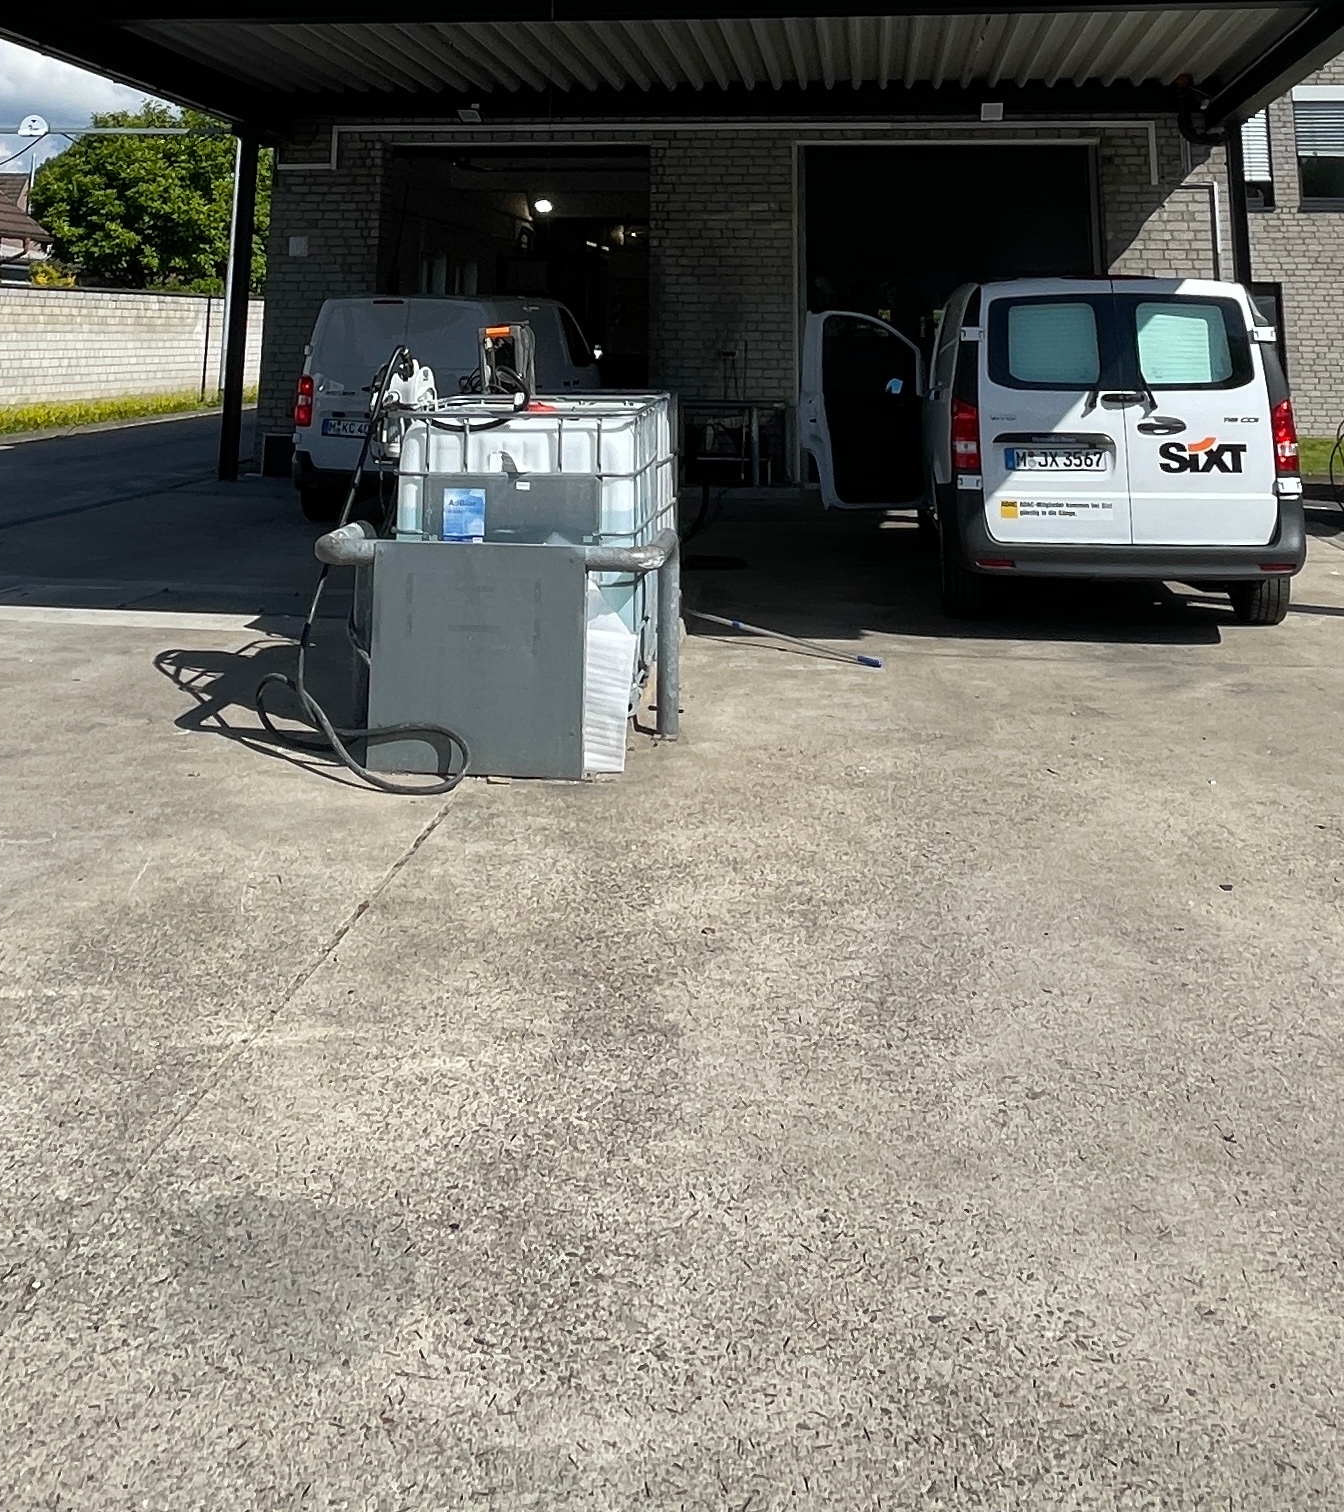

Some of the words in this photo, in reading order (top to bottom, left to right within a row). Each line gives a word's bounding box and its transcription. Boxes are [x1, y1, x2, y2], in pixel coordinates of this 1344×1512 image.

[1016, 452, 1027, 467] M
[1038, 452, 1059, 467] JX
[1063, 451, 1103, 467] 3567
[1159, 437, 1247, 473] SIXT
